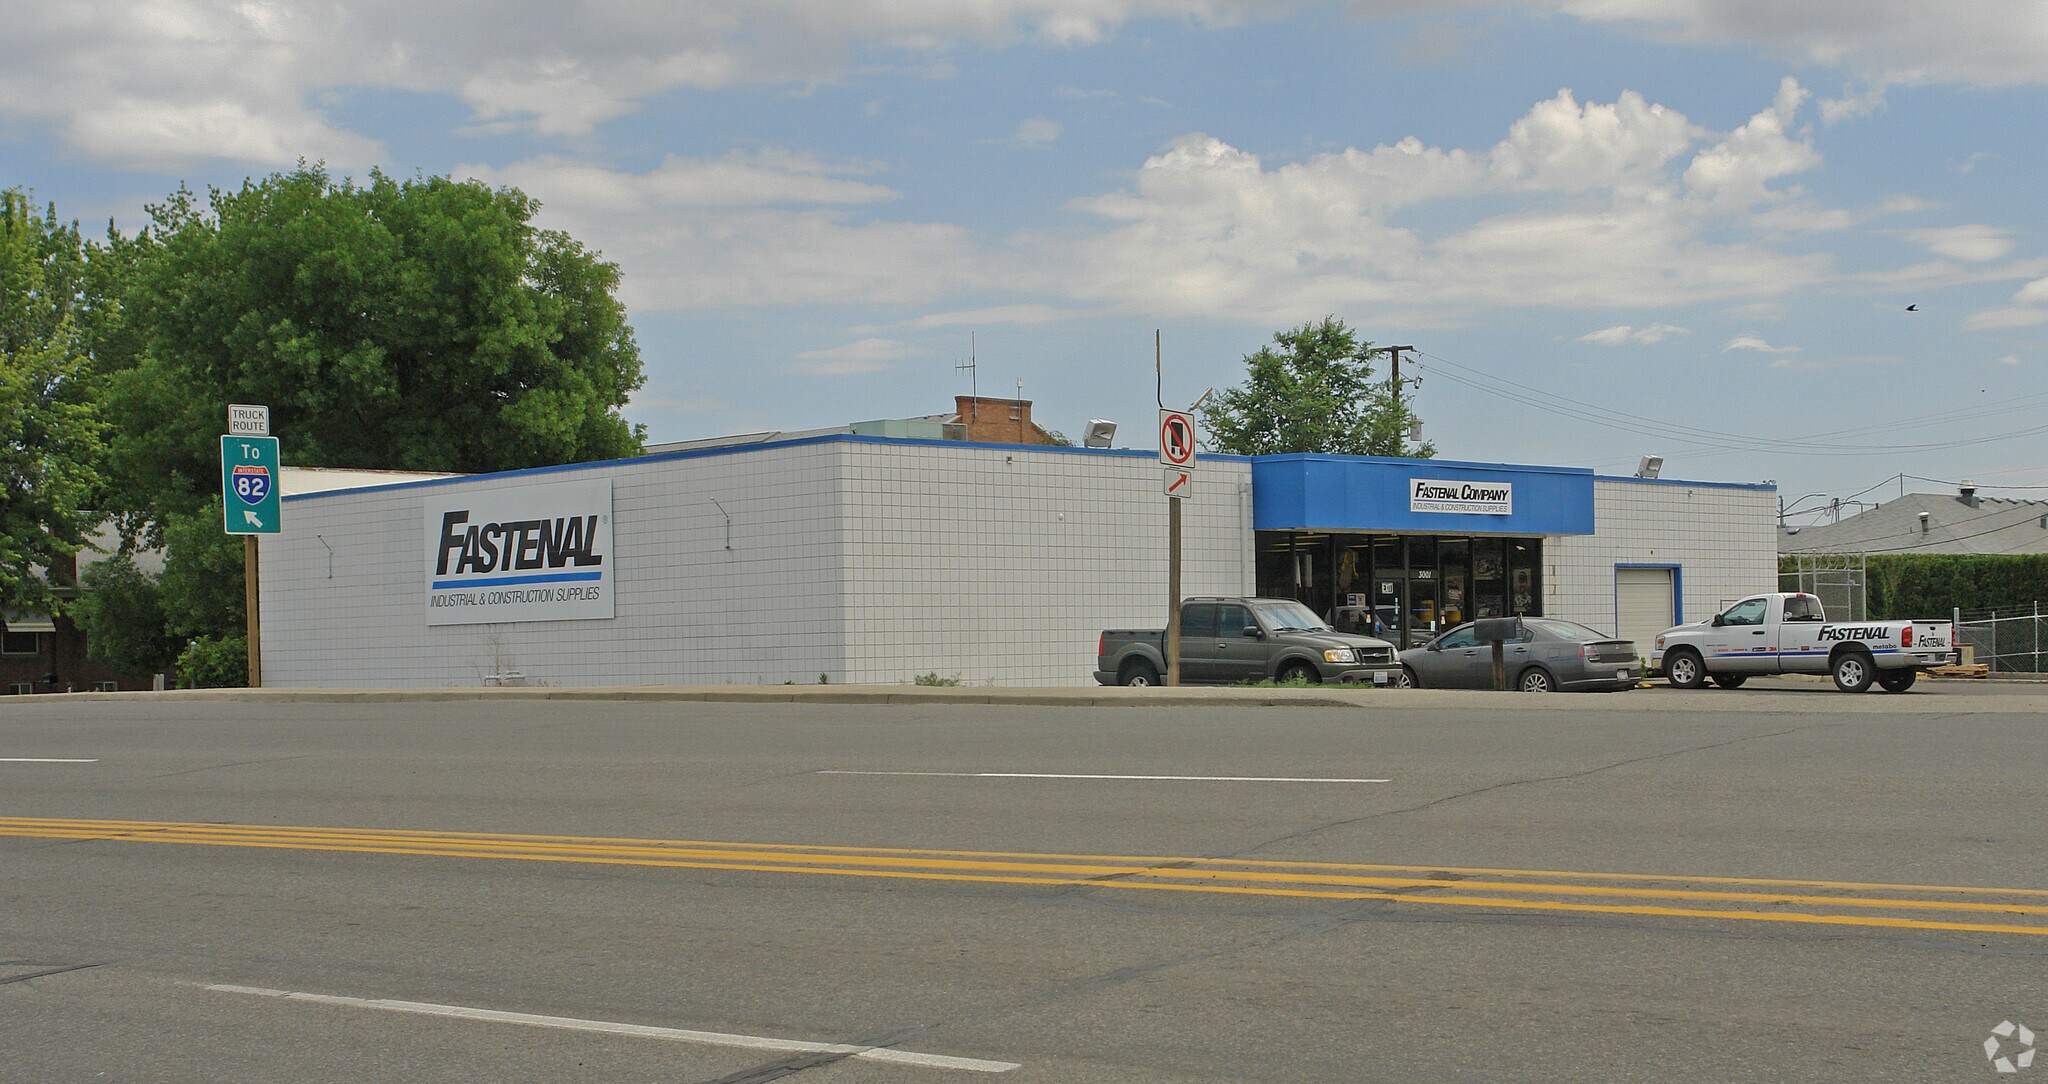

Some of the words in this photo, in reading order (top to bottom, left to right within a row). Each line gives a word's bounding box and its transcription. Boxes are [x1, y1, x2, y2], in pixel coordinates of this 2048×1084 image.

[233, 409, 264, 420] TRUCK
[233, 421, 265, 431] ROUTE
[238, 477, 265, 496] 82
[1415, 482, 1460, 500] FASTENAL
[1461, 484, 1509, 501] COMPANY
[1412, 502, 1440, 510] INDUSTRIAL
[1445, 503, 1482, 512] CONSTRUCTION
[1483, 504, 1508, 513] SUPPLIES
[436, 510, 602, 575] FASTENAL
[1418, 570, 1432, 579] 3001
[430, 593, 477, 608] INDUSTRIAL
[479, 594, 486, 605] &
[488, 588, 554, 605] CONSTRUCTION
[556, 586, 600, 602] SUPPLIES
[1817, 625, 1890, 641] FASTENAL
[1918, 635, 1946, 647] FASTENAL
